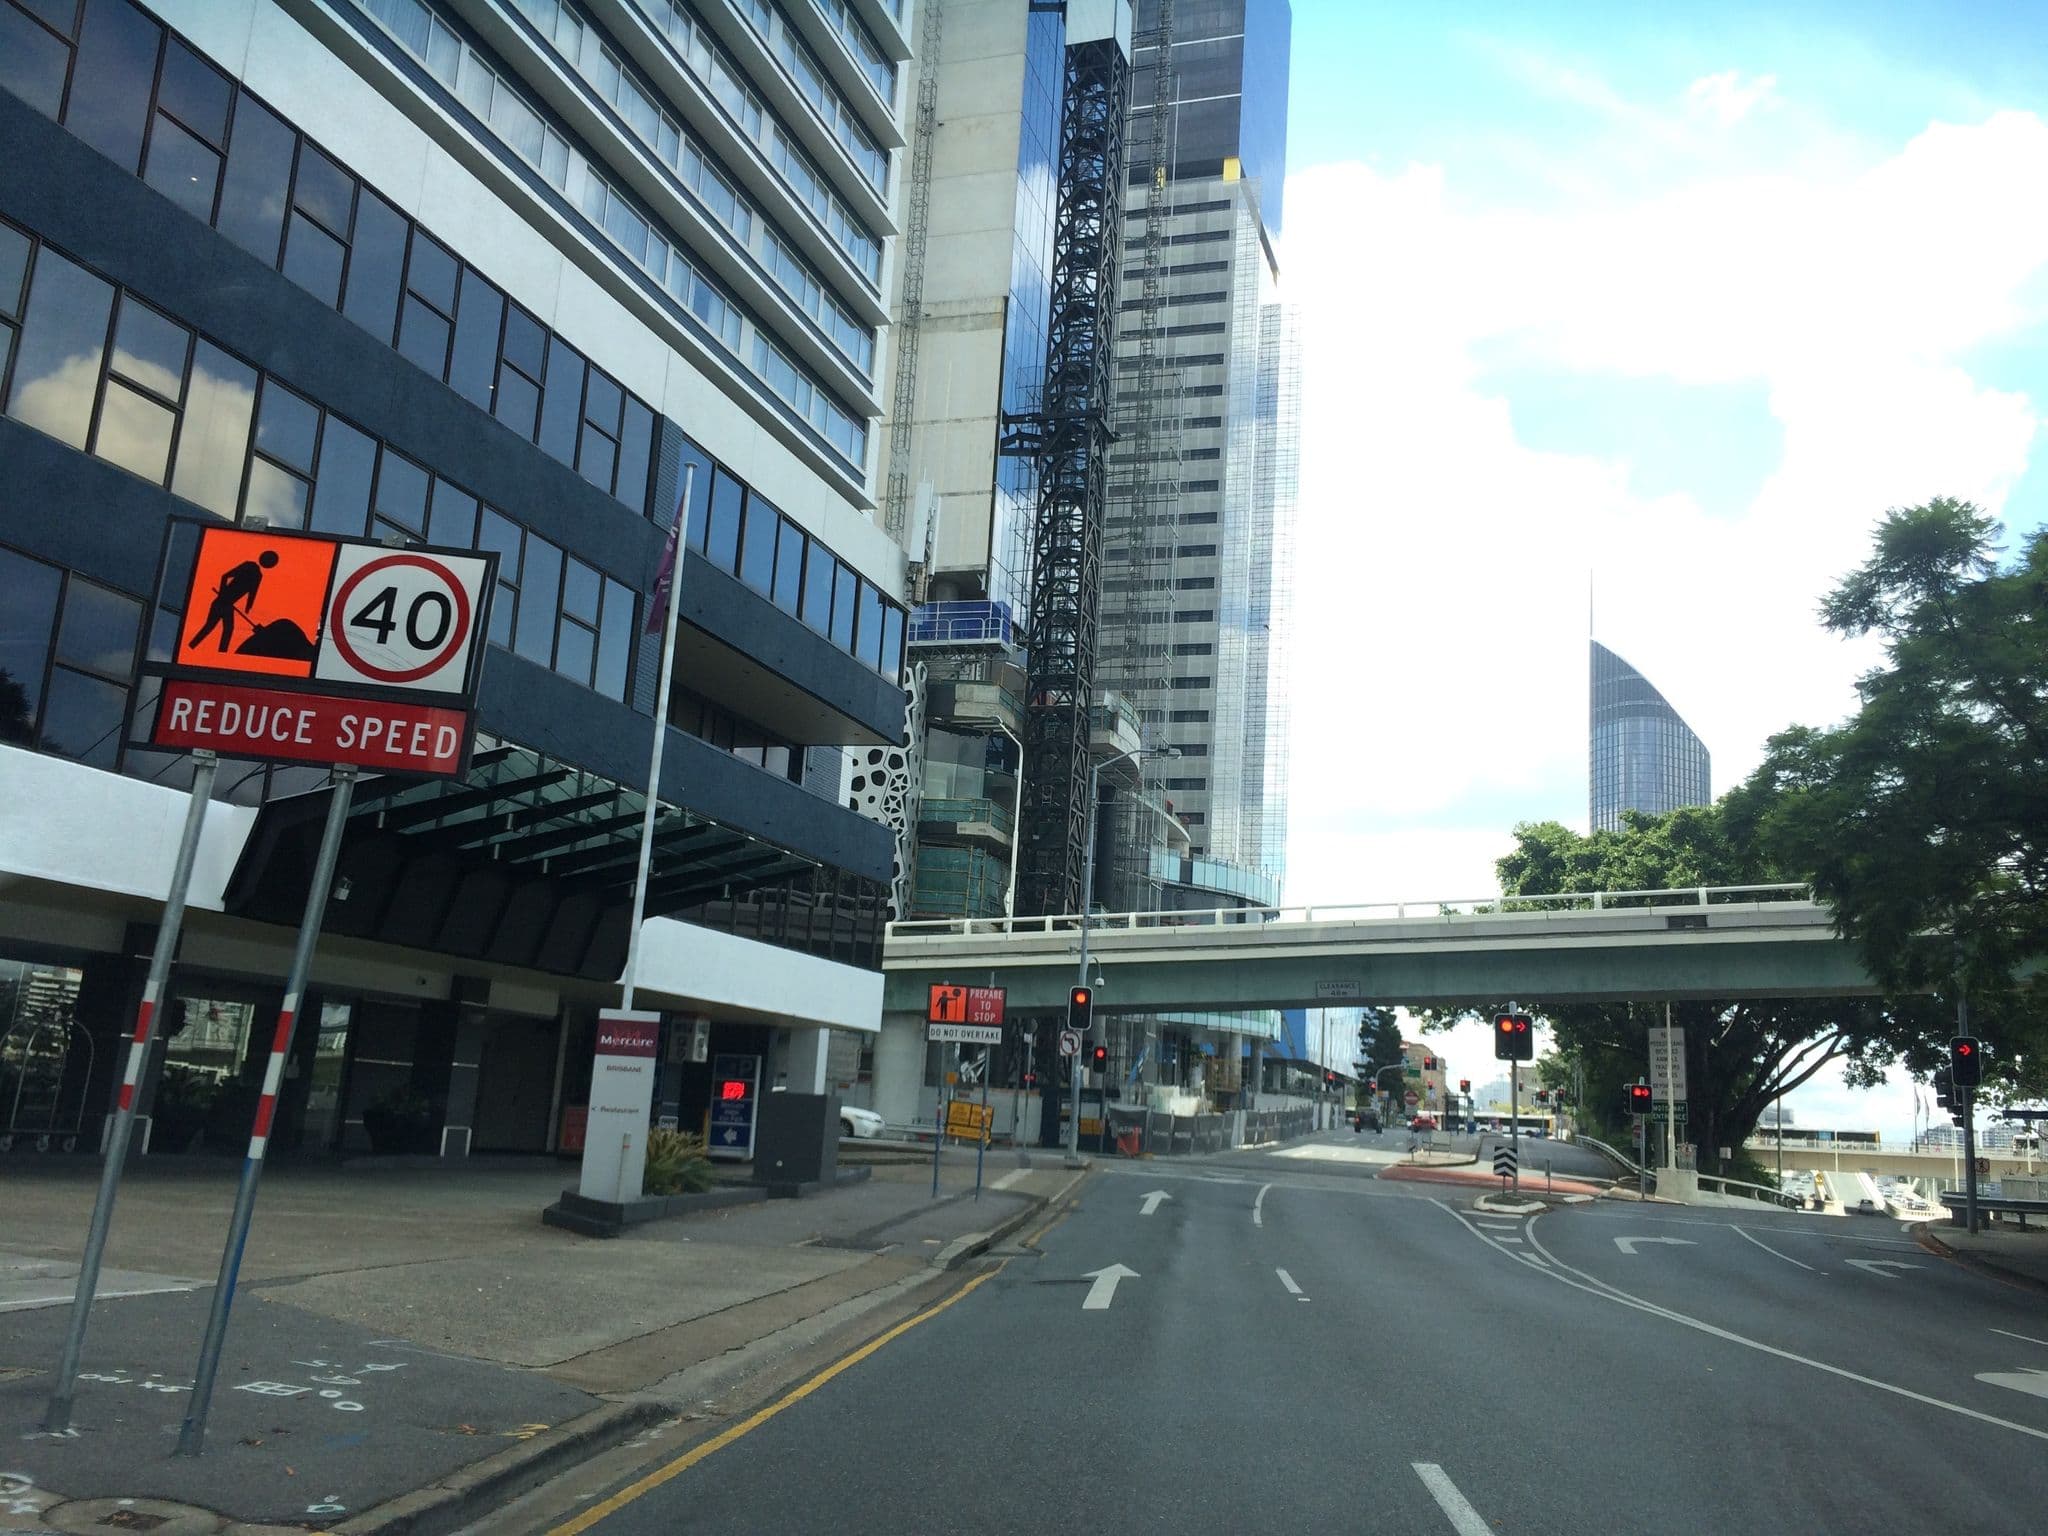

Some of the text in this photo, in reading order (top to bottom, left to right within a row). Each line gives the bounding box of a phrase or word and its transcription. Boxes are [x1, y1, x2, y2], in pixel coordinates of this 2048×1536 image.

[350, 585, 452, 651] 40
[169, 697, 458, 760] REDUCE SPEED
[970, 988, 1003, 1000] PREPARE
[981, 1001, 991, 1010] TO
[974, 1012, 996, 1023] STOP
[600, 1034, 654, 1047] Mercure
[930, 1027, 1001, 1041] DO NOT OVERTAKE
